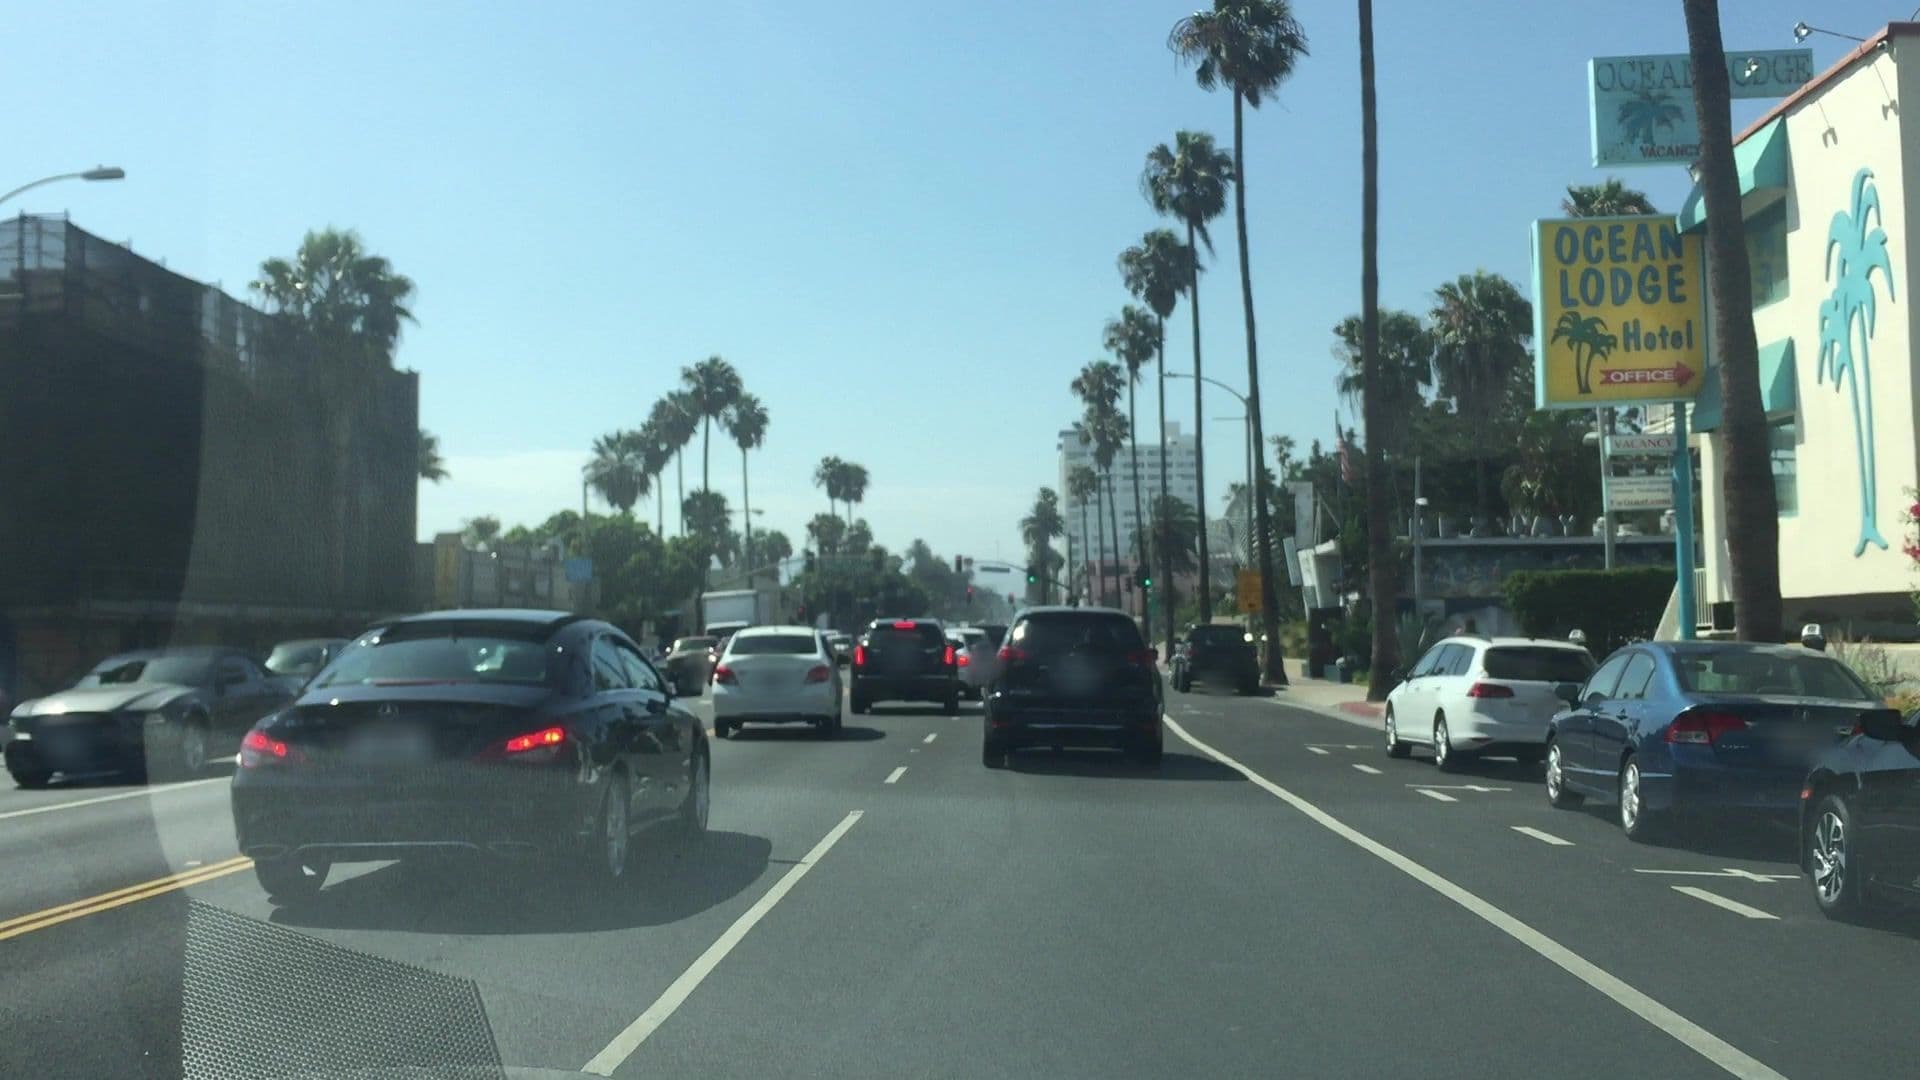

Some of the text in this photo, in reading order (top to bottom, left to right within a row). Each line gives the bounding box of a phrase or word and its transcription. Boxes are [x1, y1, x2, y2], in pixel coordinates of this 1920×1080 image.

[1731, 54, 1812, 87] ODGE
[1554, 223, 1684, 265] OCEAN
[1559, 264, 1687, 309] LODGE
[1622, 318, 1694, 352] Hotel
[1610, 369, 1675, 383] OFFICE
[1614, 438, 1673, 449] VACANCY
